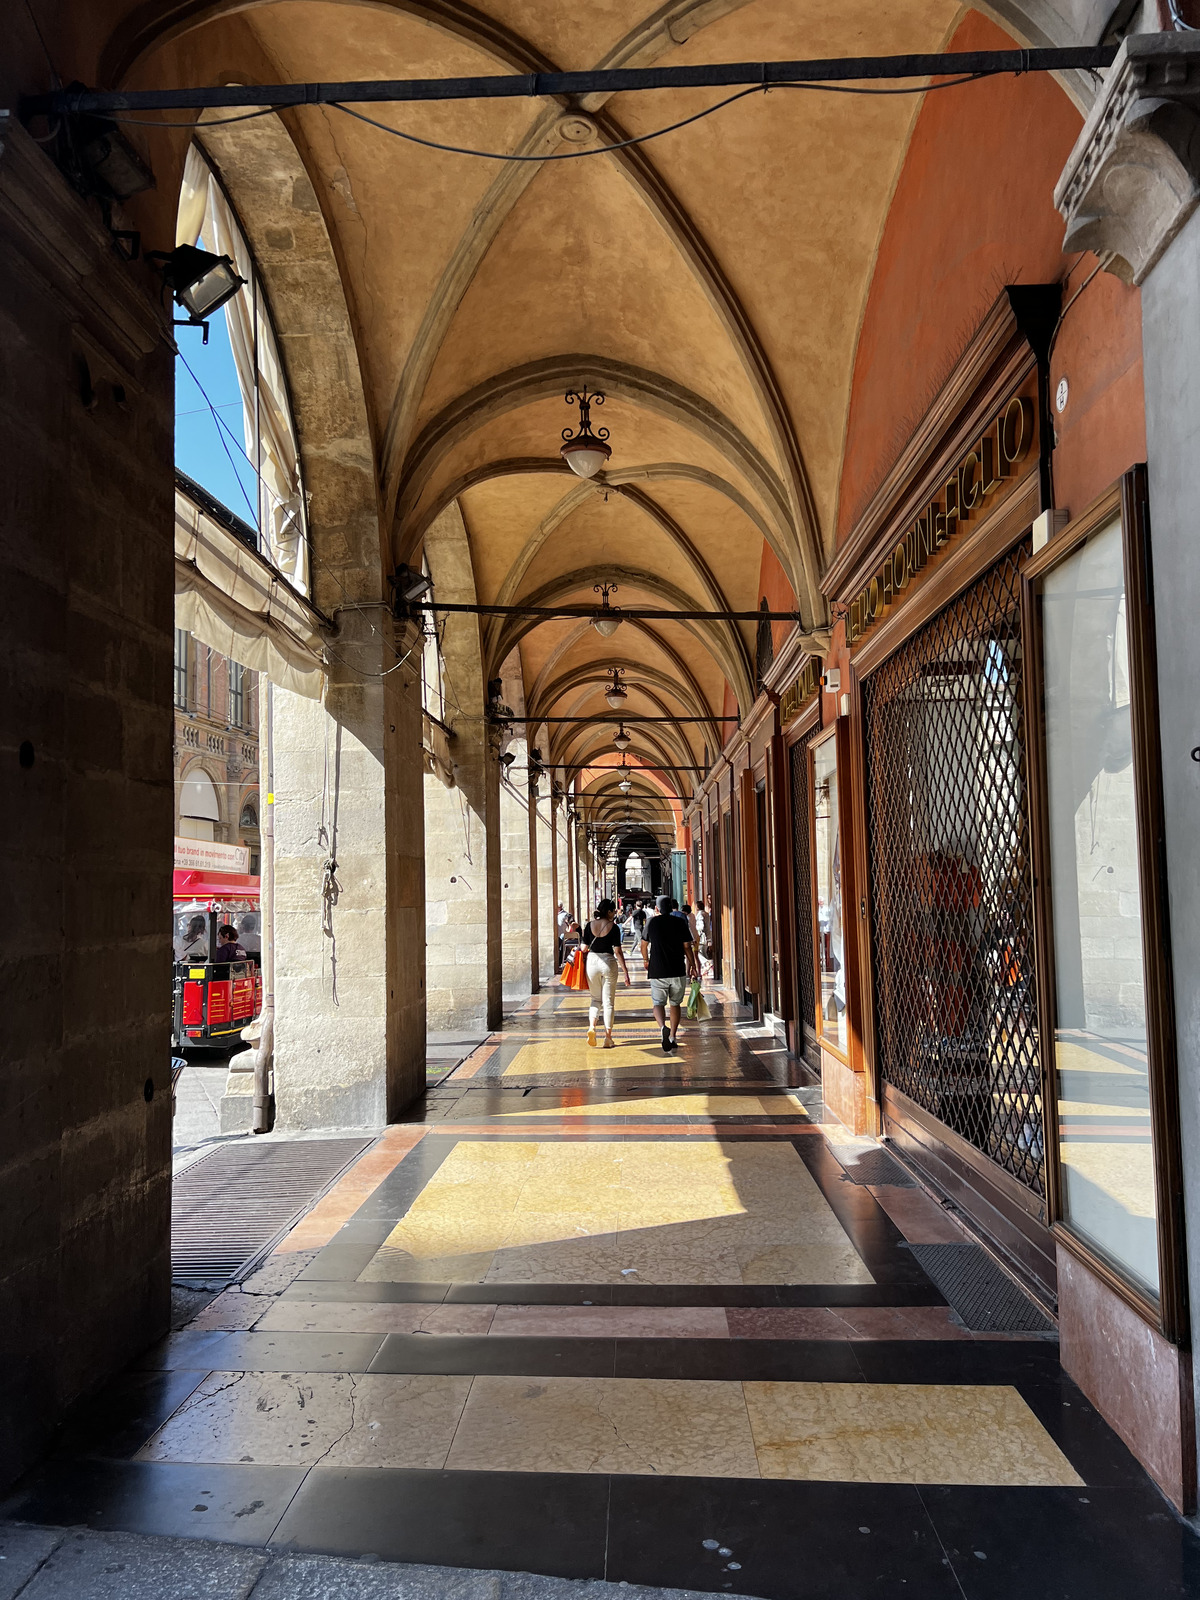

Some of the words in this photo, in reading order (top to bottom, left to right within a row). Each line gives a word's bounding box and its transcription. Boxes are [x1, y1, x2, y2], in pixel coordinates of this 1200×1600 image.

[883, 502, 939, 604] FIORINI
[935, 512, 949, 547] E
[945, 397, 1033, 534] FIGLIO
[187, 846, 199, 856] brand
